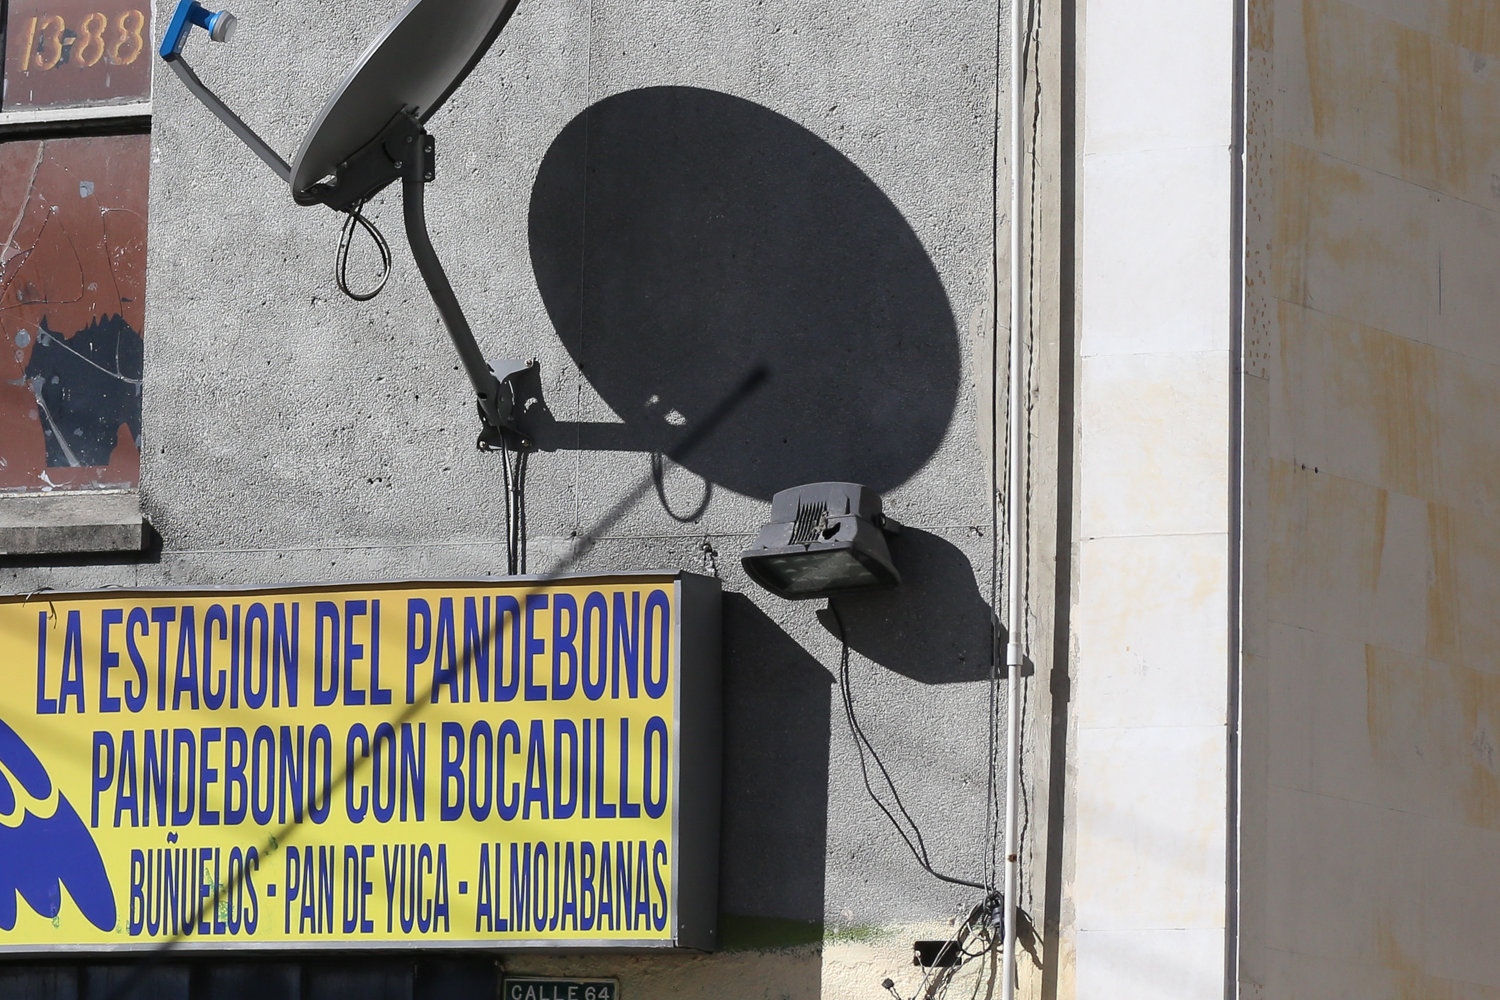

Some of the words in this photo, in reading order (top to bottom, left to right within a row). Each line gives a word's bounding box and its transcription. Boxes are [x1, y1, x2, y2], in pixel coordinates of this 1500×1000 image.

[19, 9, 146, 71] 13-88
[38, 611, 84, 713] LA
[101, 603, 298, 712] ESTACION
[316, 600, 391, 706] DEL
[407, 590, 669, 703] PANDEBONO
[93, 725, 331, 827] PANDEBONO
[347, 723, 425, 823] CON
[442, 717, 667, 821] BOCADILLO
[130, 833, 257, 935] BUÑUELOS
[287, 846, 333, 932] PAN
[344, 846, 374, 933] DE
[385, 844, 448, 932] YUCA
[478, 841, 667, 931] ALMOJABANAS
[511, 985, 579, 1000] CALLE
[584, 986, 610, 1000] 64
